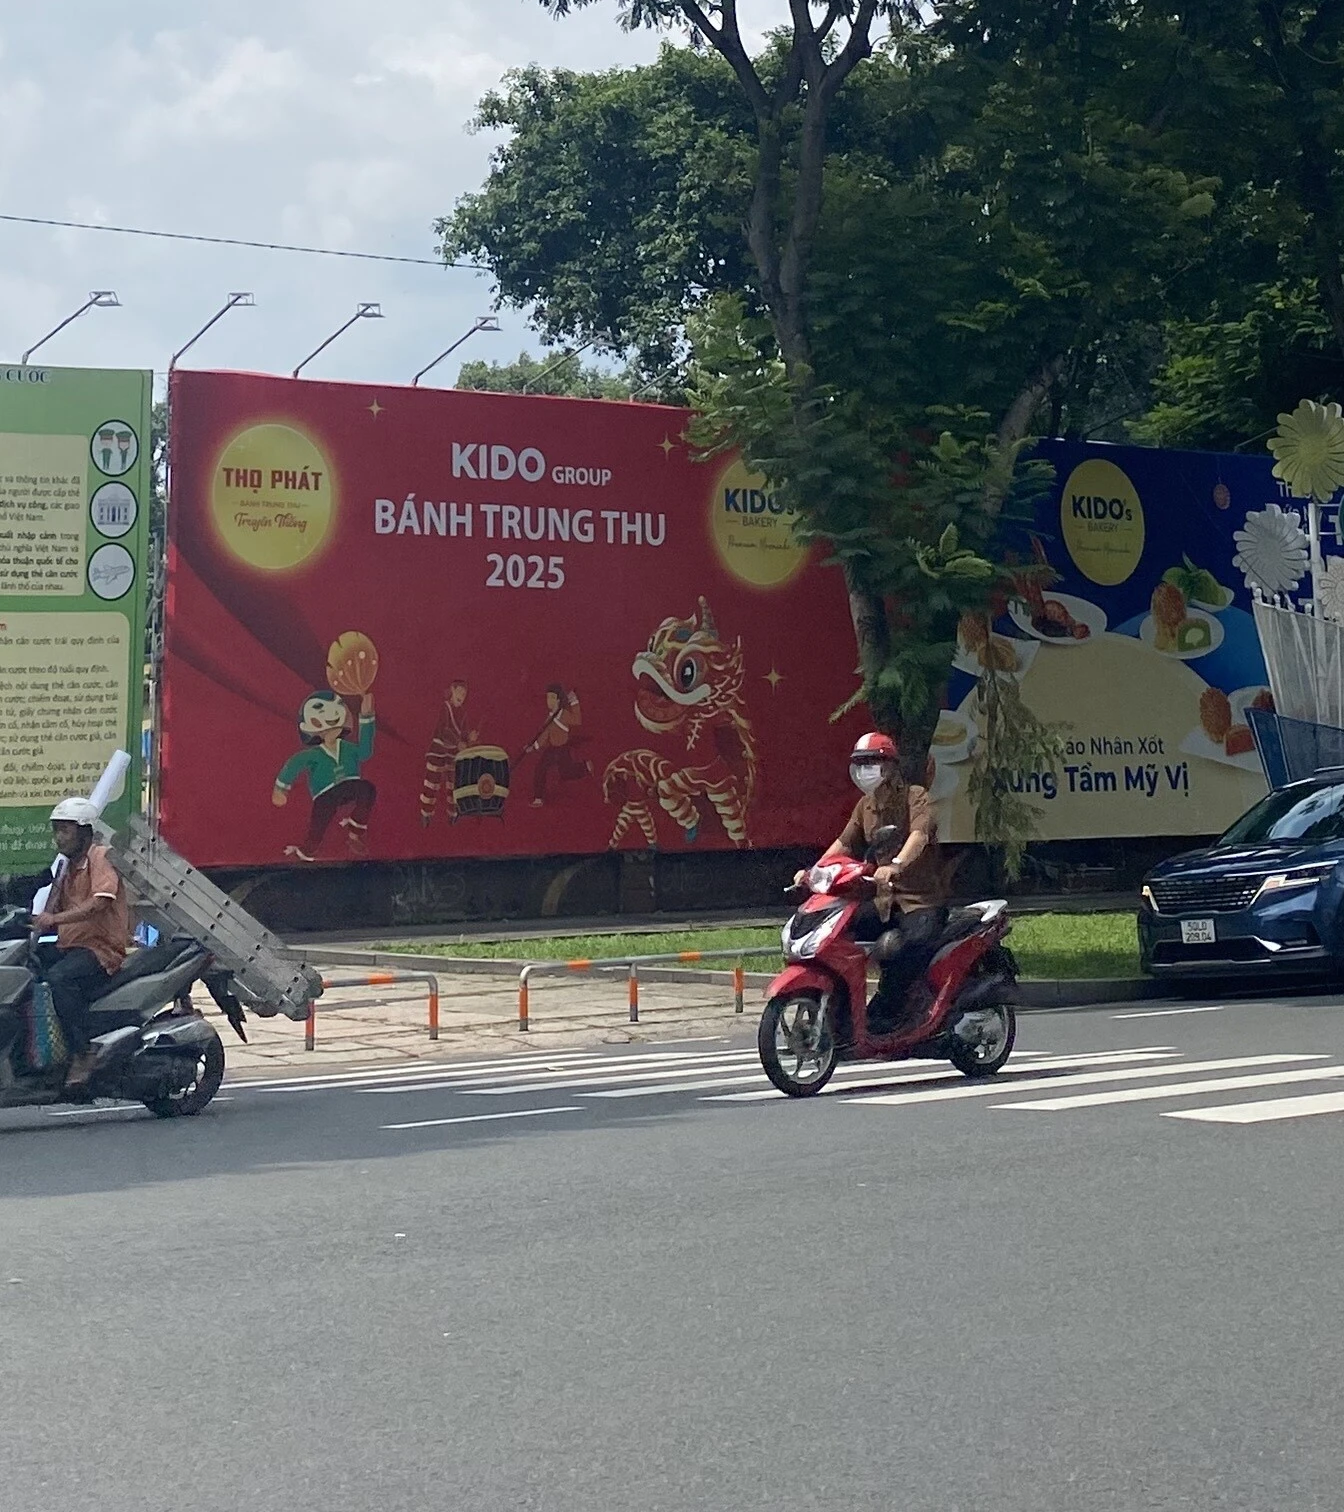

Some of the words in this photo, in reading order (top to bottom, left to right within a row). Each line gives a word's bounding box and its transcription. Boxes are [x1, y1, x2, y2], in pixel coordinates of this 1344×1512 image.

[222, 467, 262, 494] THỌ
[271, 465, 323, 491] PHÁT
[451, 441, 546, 483] KIDO
[552, 465, 613, 487] GROUP
[374, 493, 473, 537] BÁNH
[479, 502, 595, 544] TRUNG
[600, 509, 666, 547] THU
[742, 516, 778, 528] BAKERY
[485, 552, 565, 590] 2025
[1090, 736, 1134, 755] Nhân
[1138, 735, 1165, 754] Xốt
[1063, 762, 1117, 792] Tầm
[1124, 763, 1159, 797] Mỹ
[1165, 762, 1189, 797] Vị
